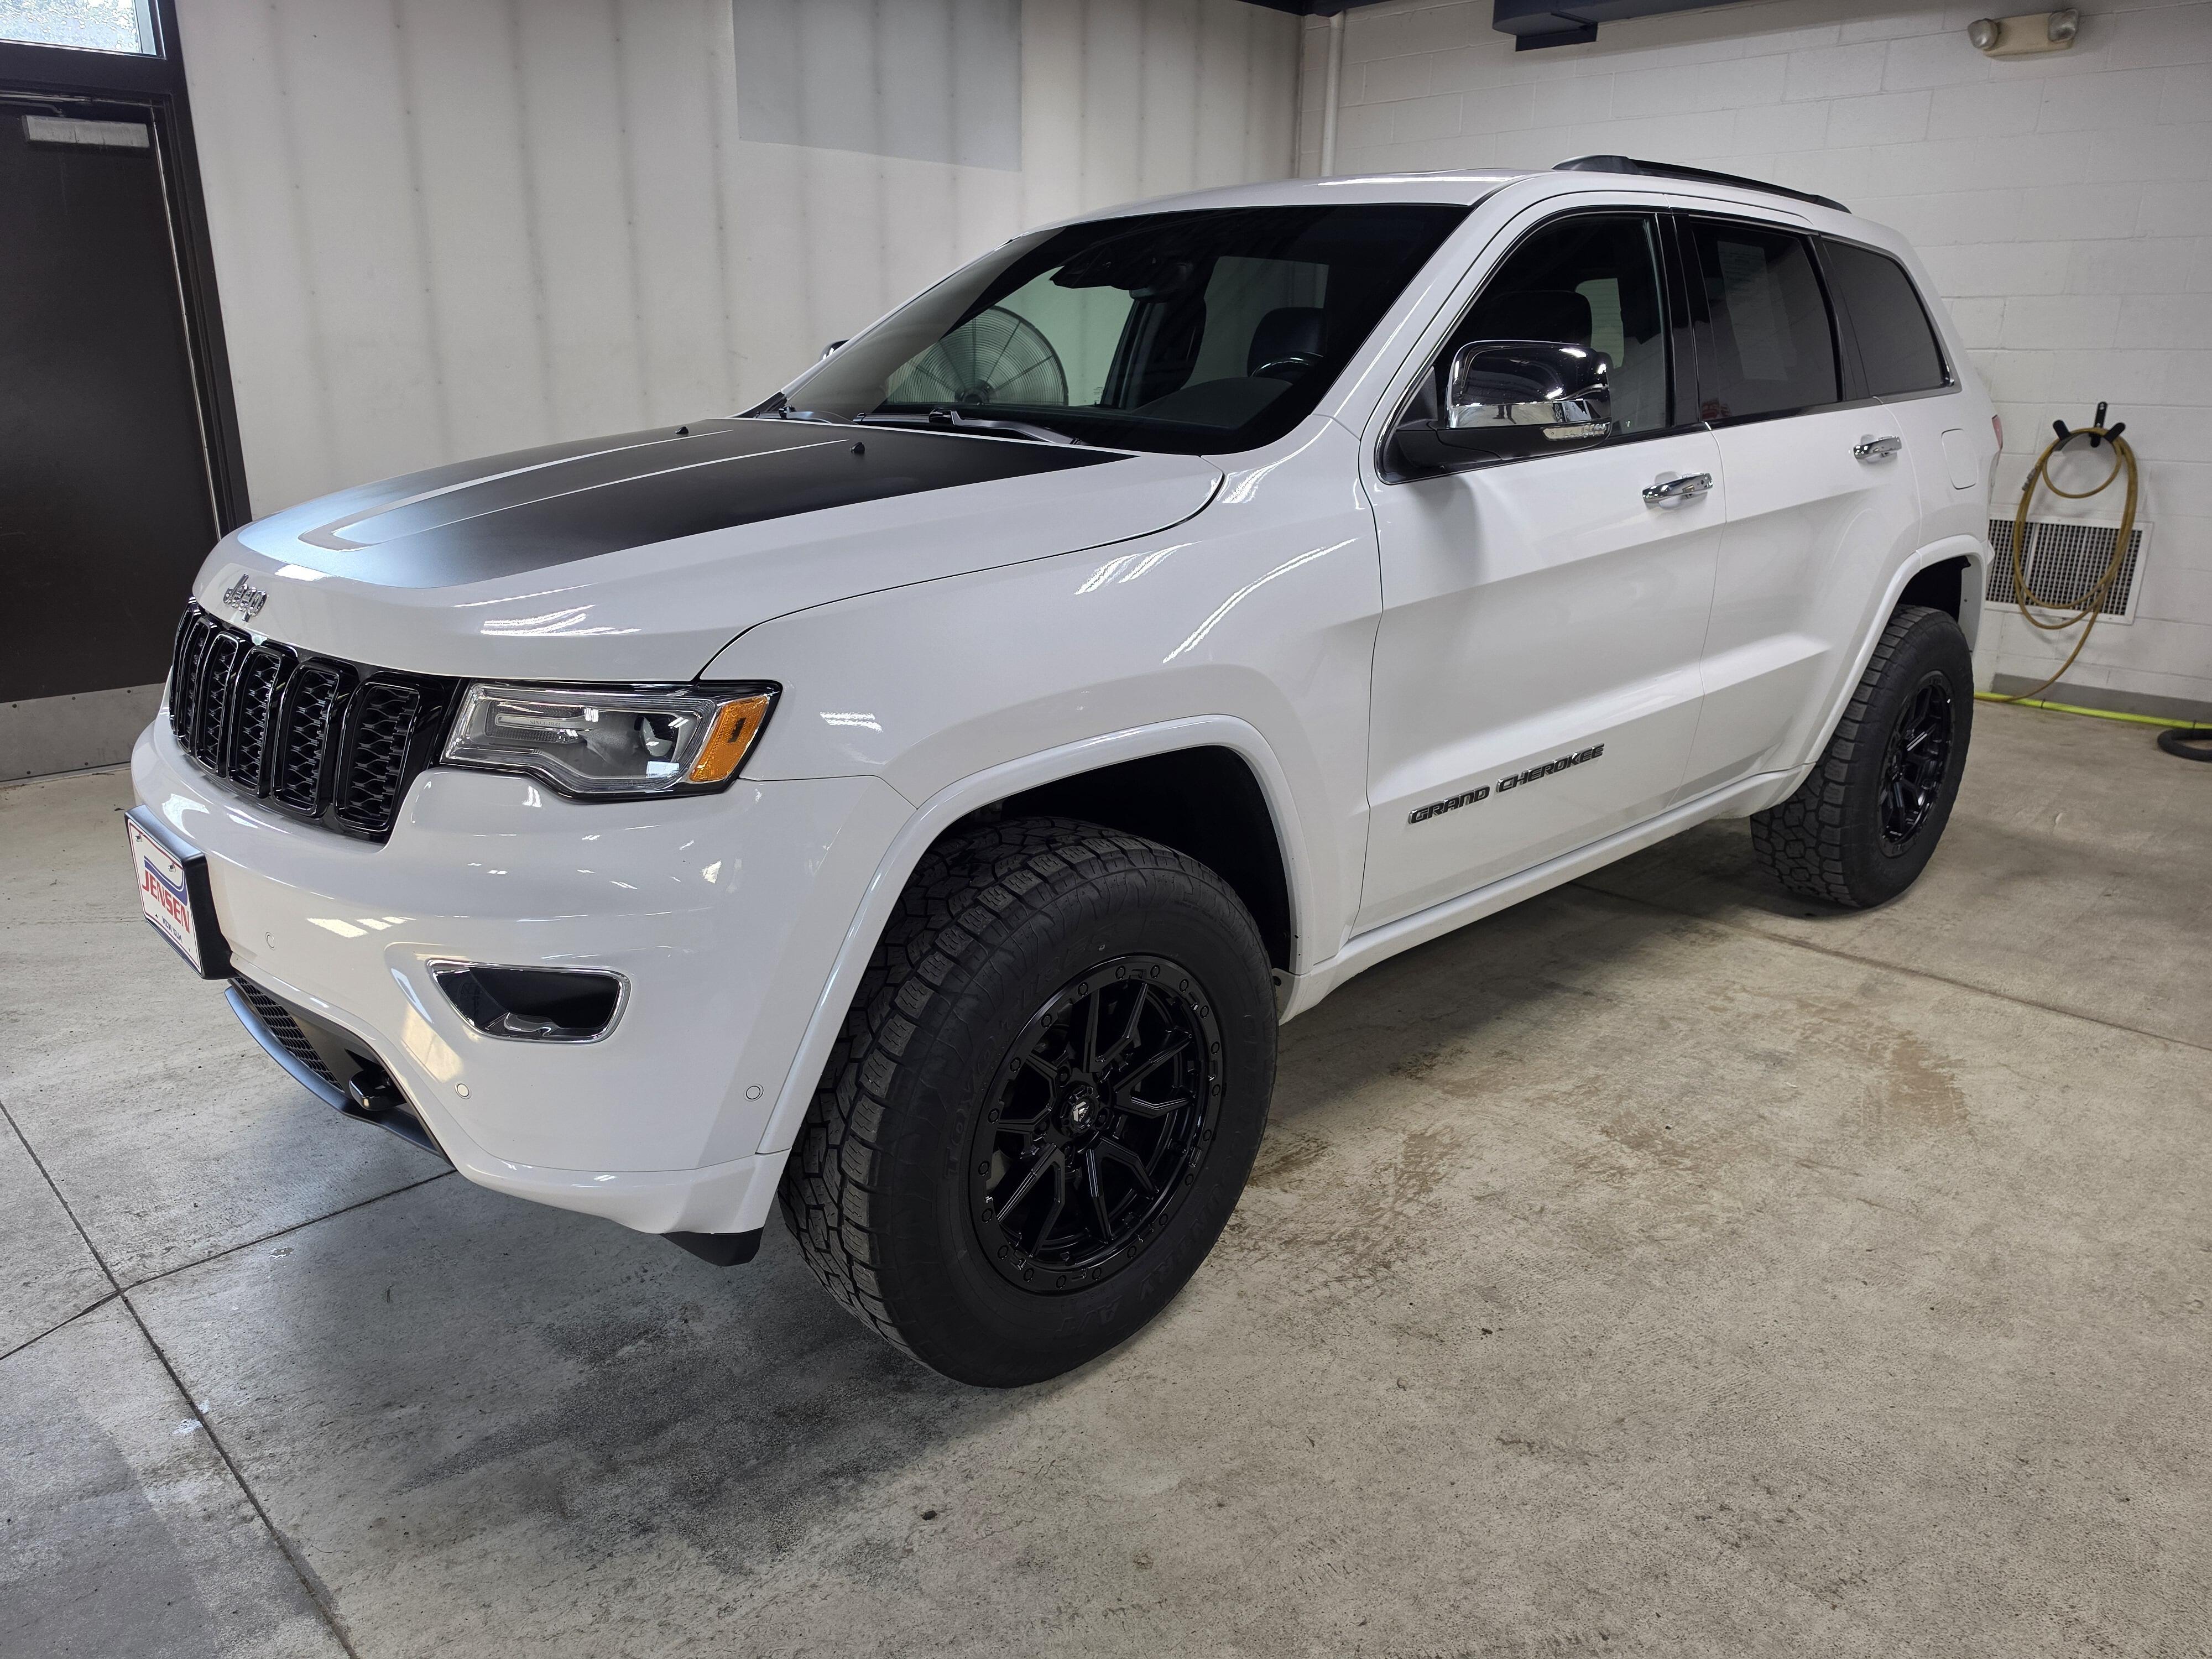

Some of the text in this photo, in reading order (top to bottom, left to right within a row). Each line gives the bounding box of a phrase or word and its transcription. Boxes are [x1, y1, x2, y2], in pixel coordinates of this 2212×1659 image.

[223, 574, 268, 622] Jeep
[1408, 743, 1604, 824] GRAND CHEROKEE
[142, 869, 190, 934] JENSEN
[943, 1033, 998, 1180] TOYO
